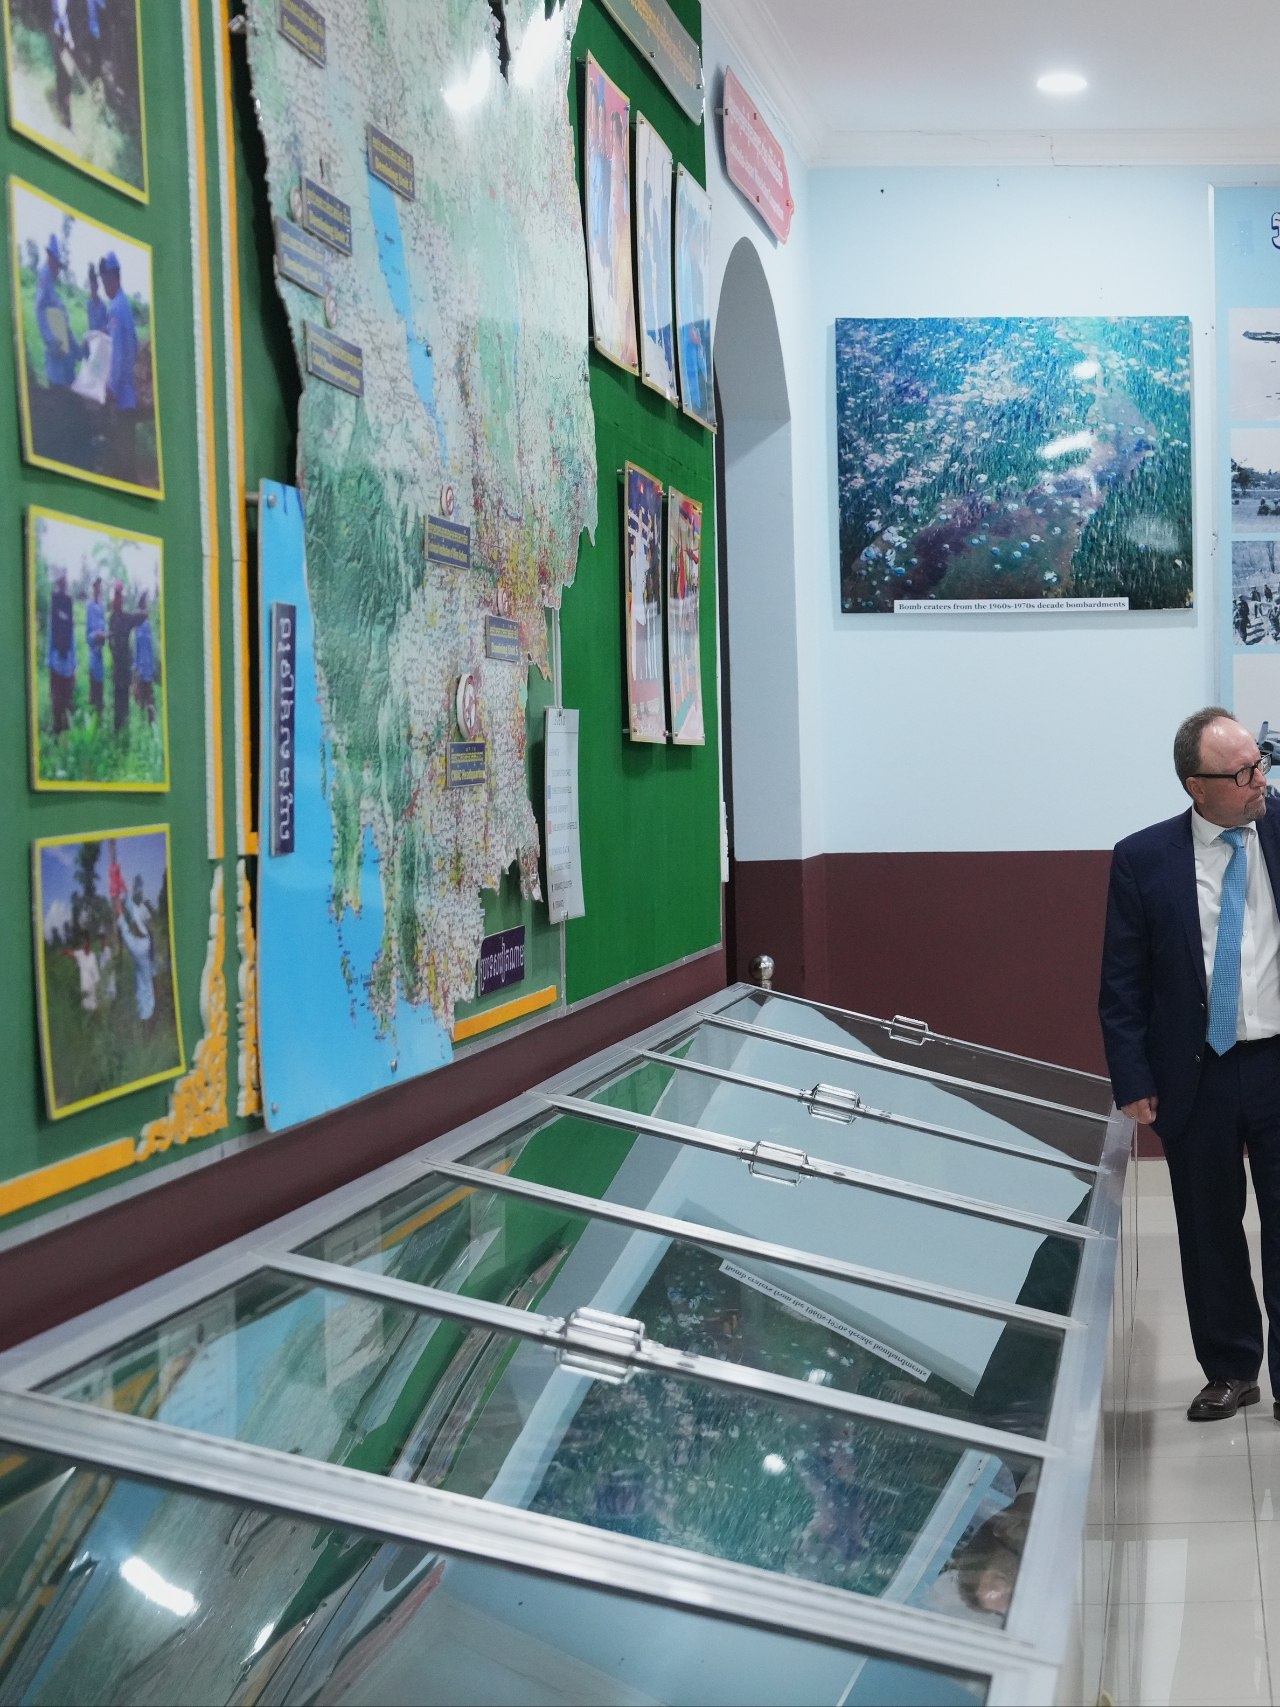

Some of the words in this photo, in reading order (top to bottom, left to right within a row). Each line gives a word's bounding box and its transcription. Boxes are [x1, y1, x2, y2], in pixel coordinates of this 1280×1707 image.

[974, 602, 987, 610] the
[988, 602, 1036, 610] 1960s-1970s
[1037, 601, 1064, 609] decade
[1065, 600, 1126, 609] bombardments
